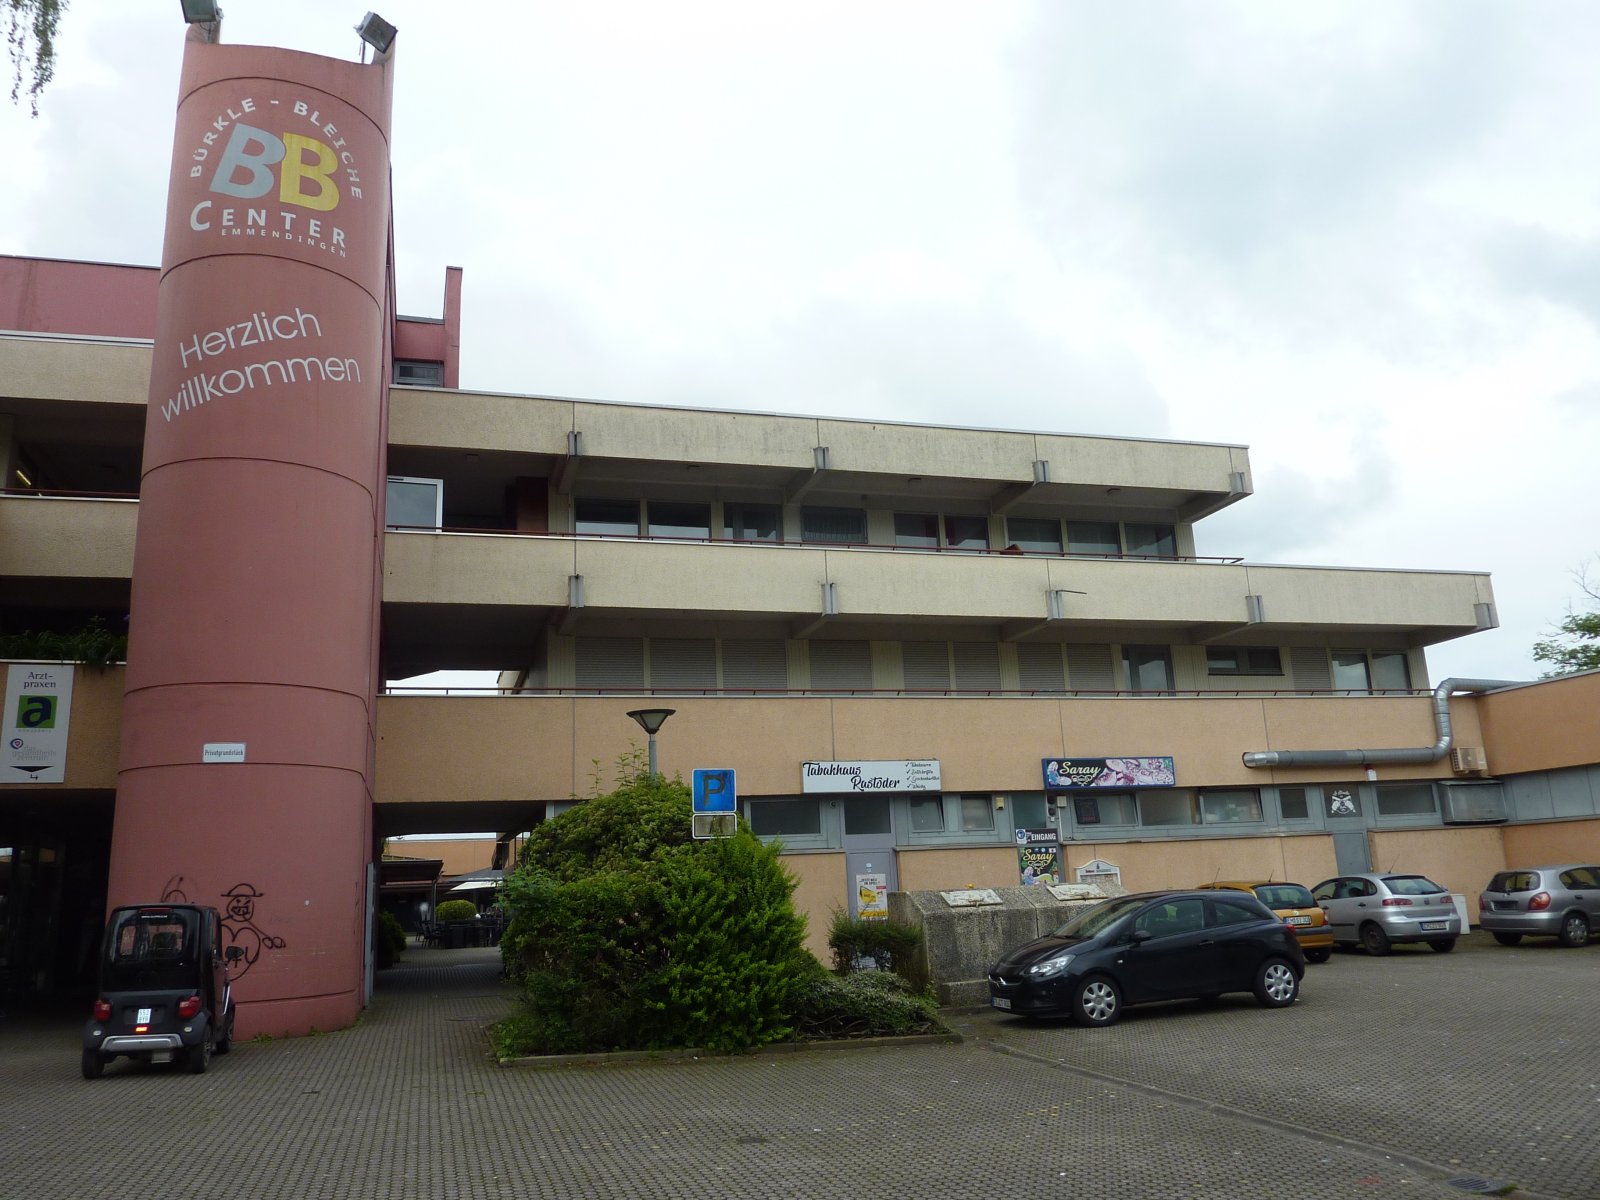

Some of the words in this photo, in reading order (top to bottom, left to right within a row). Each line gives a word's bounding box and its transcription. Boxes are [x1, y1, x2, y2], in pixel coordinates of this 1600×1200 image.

[190, 98, 256, 178] BÜRKLE
[293, 100, 363, 200] BLEICHE
[209, 123, 340, 211] BB
[190, 201, 346, 248] CENTER
[221, 228, 346, 258] EMMENDINGEN
[179, 307, 322, 369] Herzlich
[161, 357, 361, 422] willkommen
[23, 681, 56, 689] praxen
[28, 671, 54, 680] Arzt-
[204, 749, 244, 757] Privatgrundstück
[803, 762, 862, 777] Tabakhaus
[1059, 761, 1101, 777] Saray
[704, 774, 726, 807] P
[1031, 833, 1057, 841] EINGANG
[1023, 848, 1055, 865] Saray
